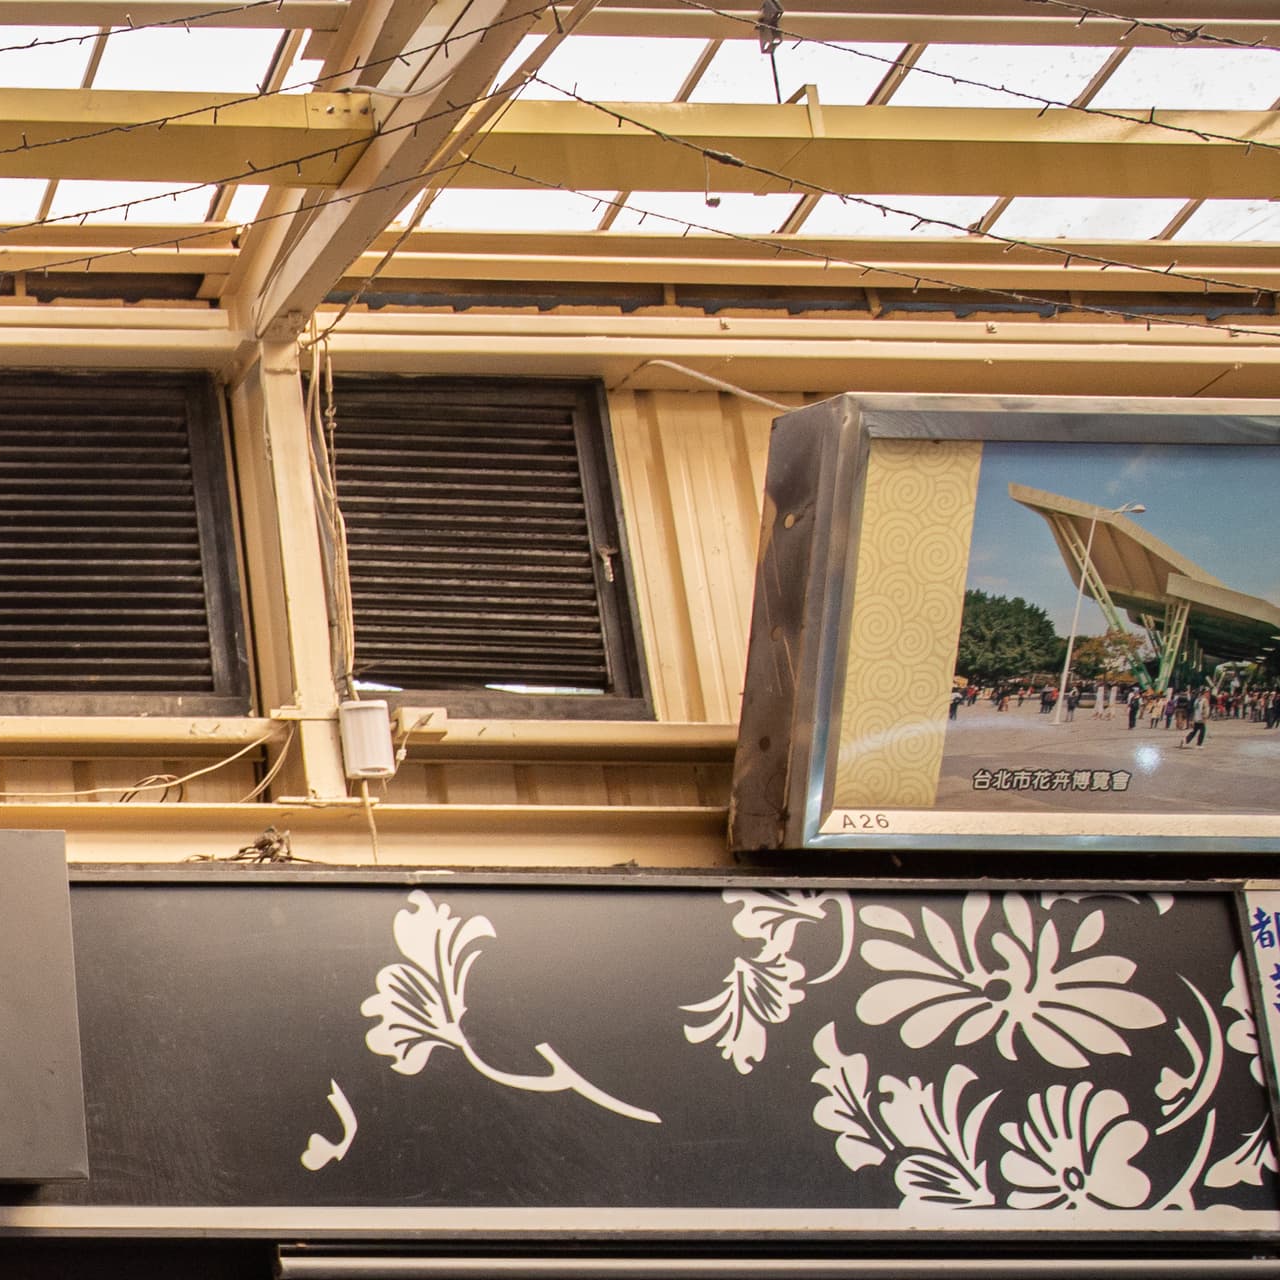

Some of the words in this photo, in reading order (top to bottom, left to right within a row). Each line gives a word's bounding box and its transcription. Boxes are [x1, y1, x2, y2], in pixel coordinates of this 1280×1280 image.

[972, 769, 1132, 792] 台北市花卉博覽會
[842, 814, 889, 829] A26
